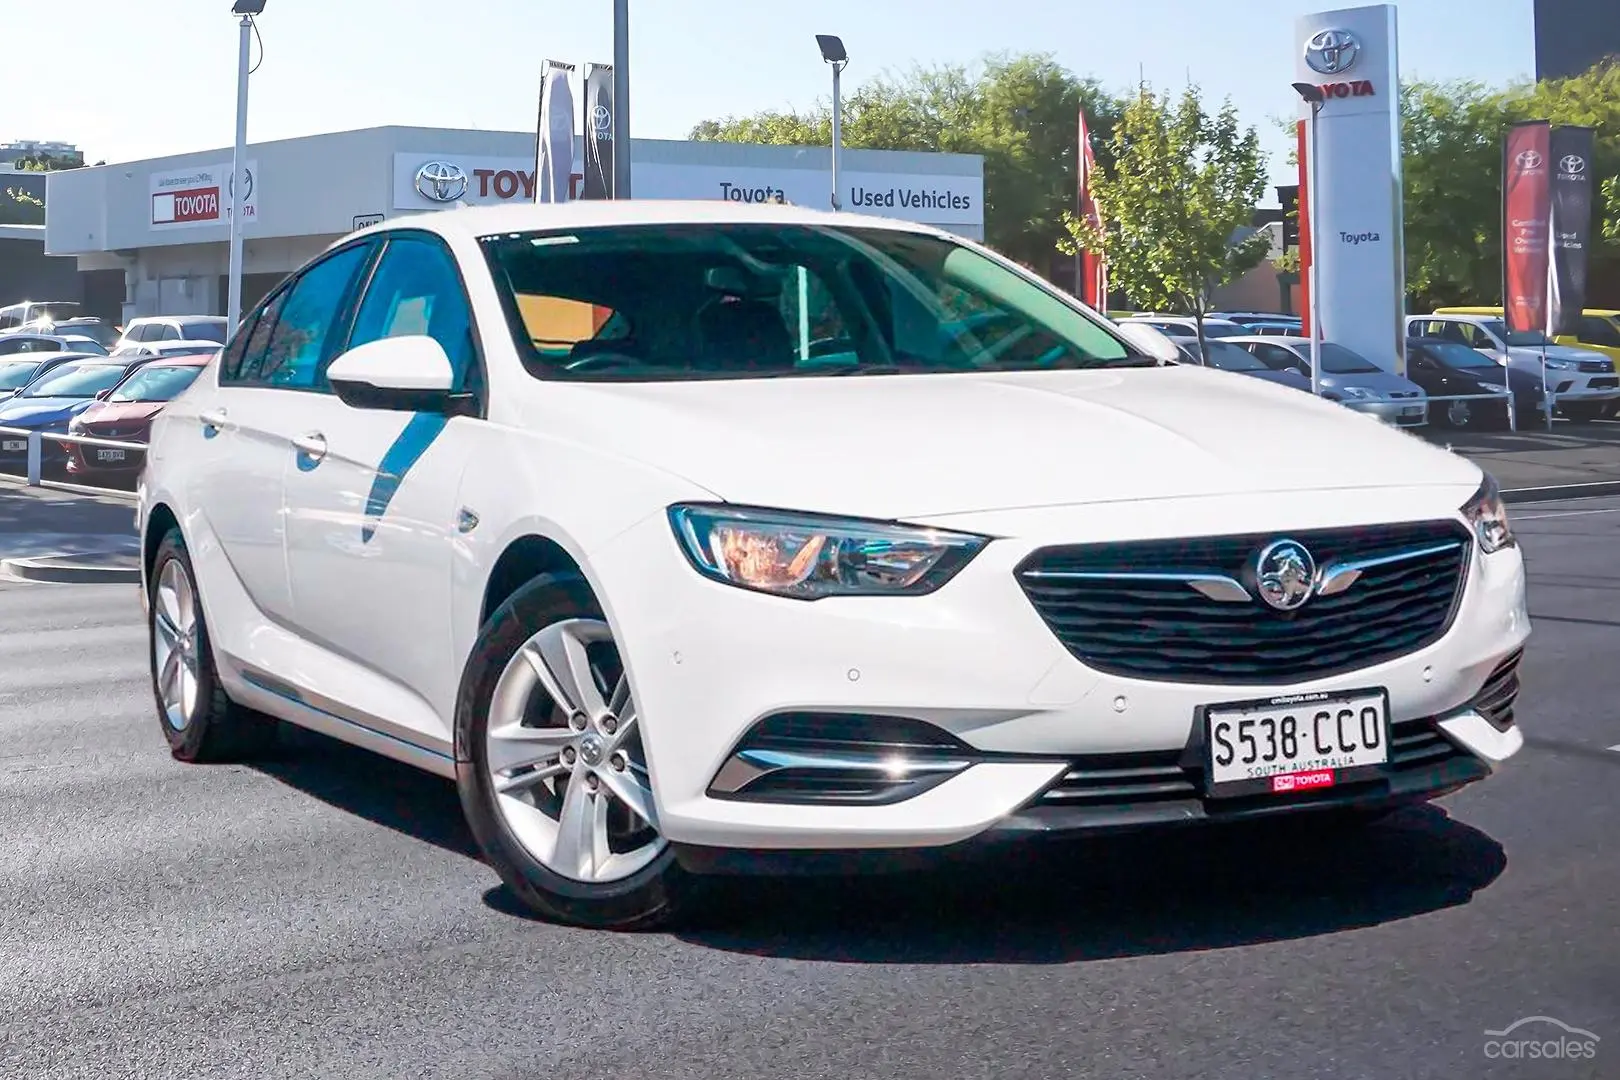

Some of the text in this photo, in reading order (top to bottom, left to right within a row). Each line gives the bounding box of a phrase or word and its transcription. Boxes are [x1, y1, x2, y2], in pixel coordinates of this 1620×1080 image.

[1316, 80, 1376, 99] YOTA
[473, 169, 584, 200] TOYT
[175, 194, 217, 216] TOYOTA
[851, 187, 970, 210] Used Vehicles
[1339, 231, 1380, 245] Toyota
[1247, 756, 1355, 777] SOUTH AUSTRALIA
[1295, 773, 1331, 785] TOYOTA
